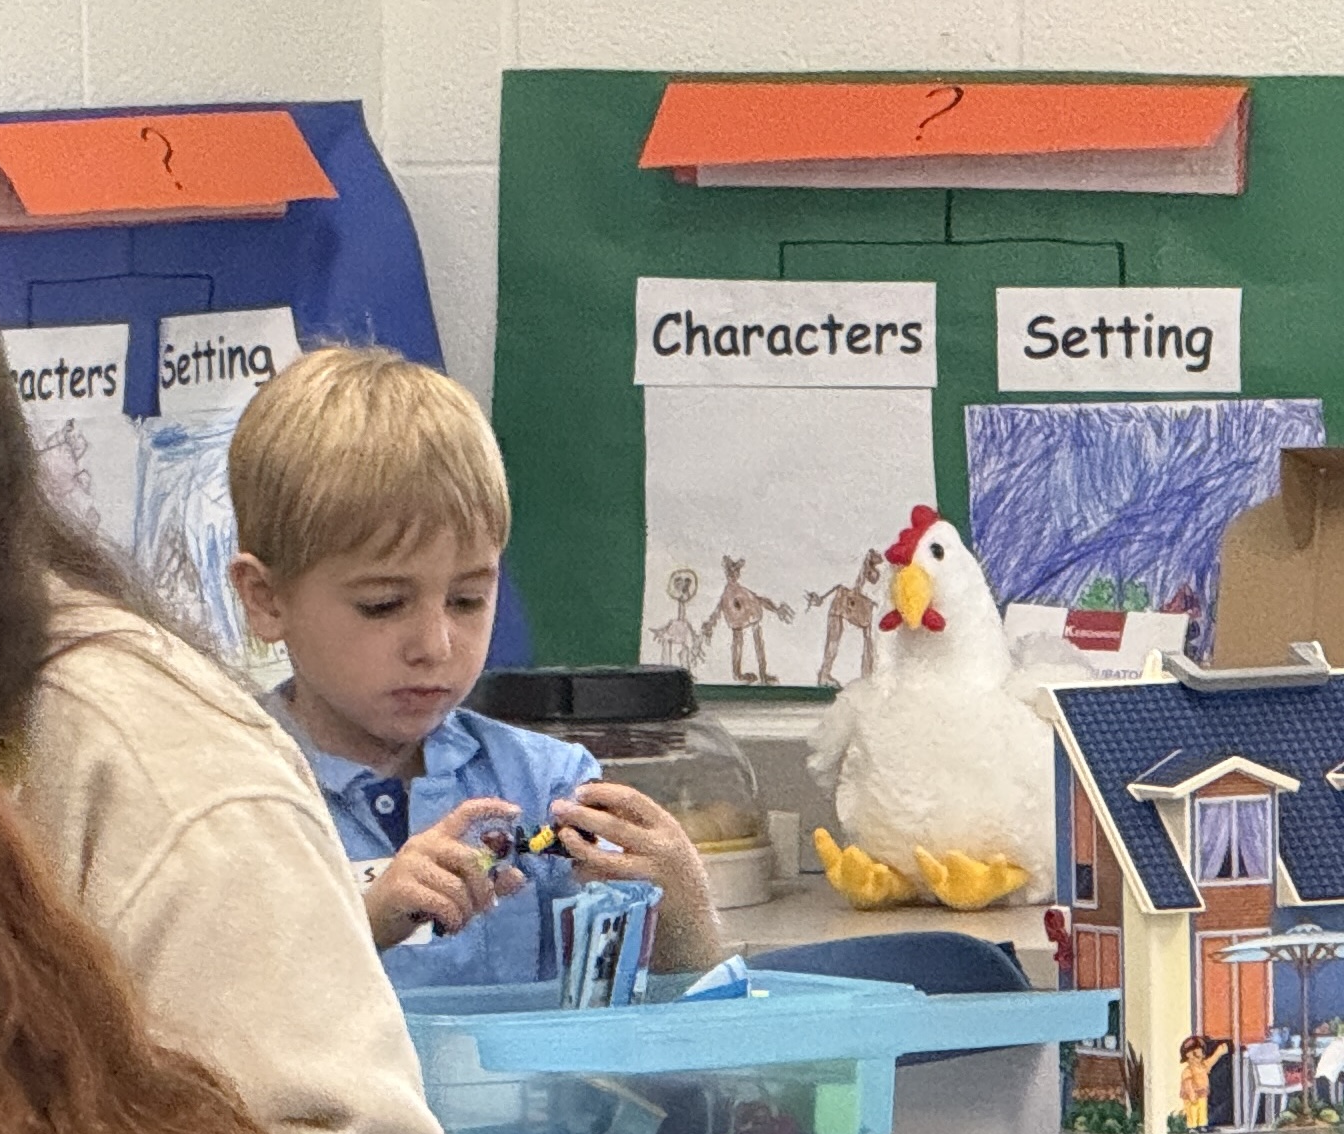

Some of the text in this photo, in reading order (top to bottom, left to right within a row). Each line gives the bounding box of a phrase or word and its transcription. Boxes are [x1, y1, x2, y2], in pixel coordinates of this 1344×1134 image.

[160, 335, 277, 390] Setting
[652, 312, 923, 358] Characters
[1023, 313, 1214, 374] Setting
